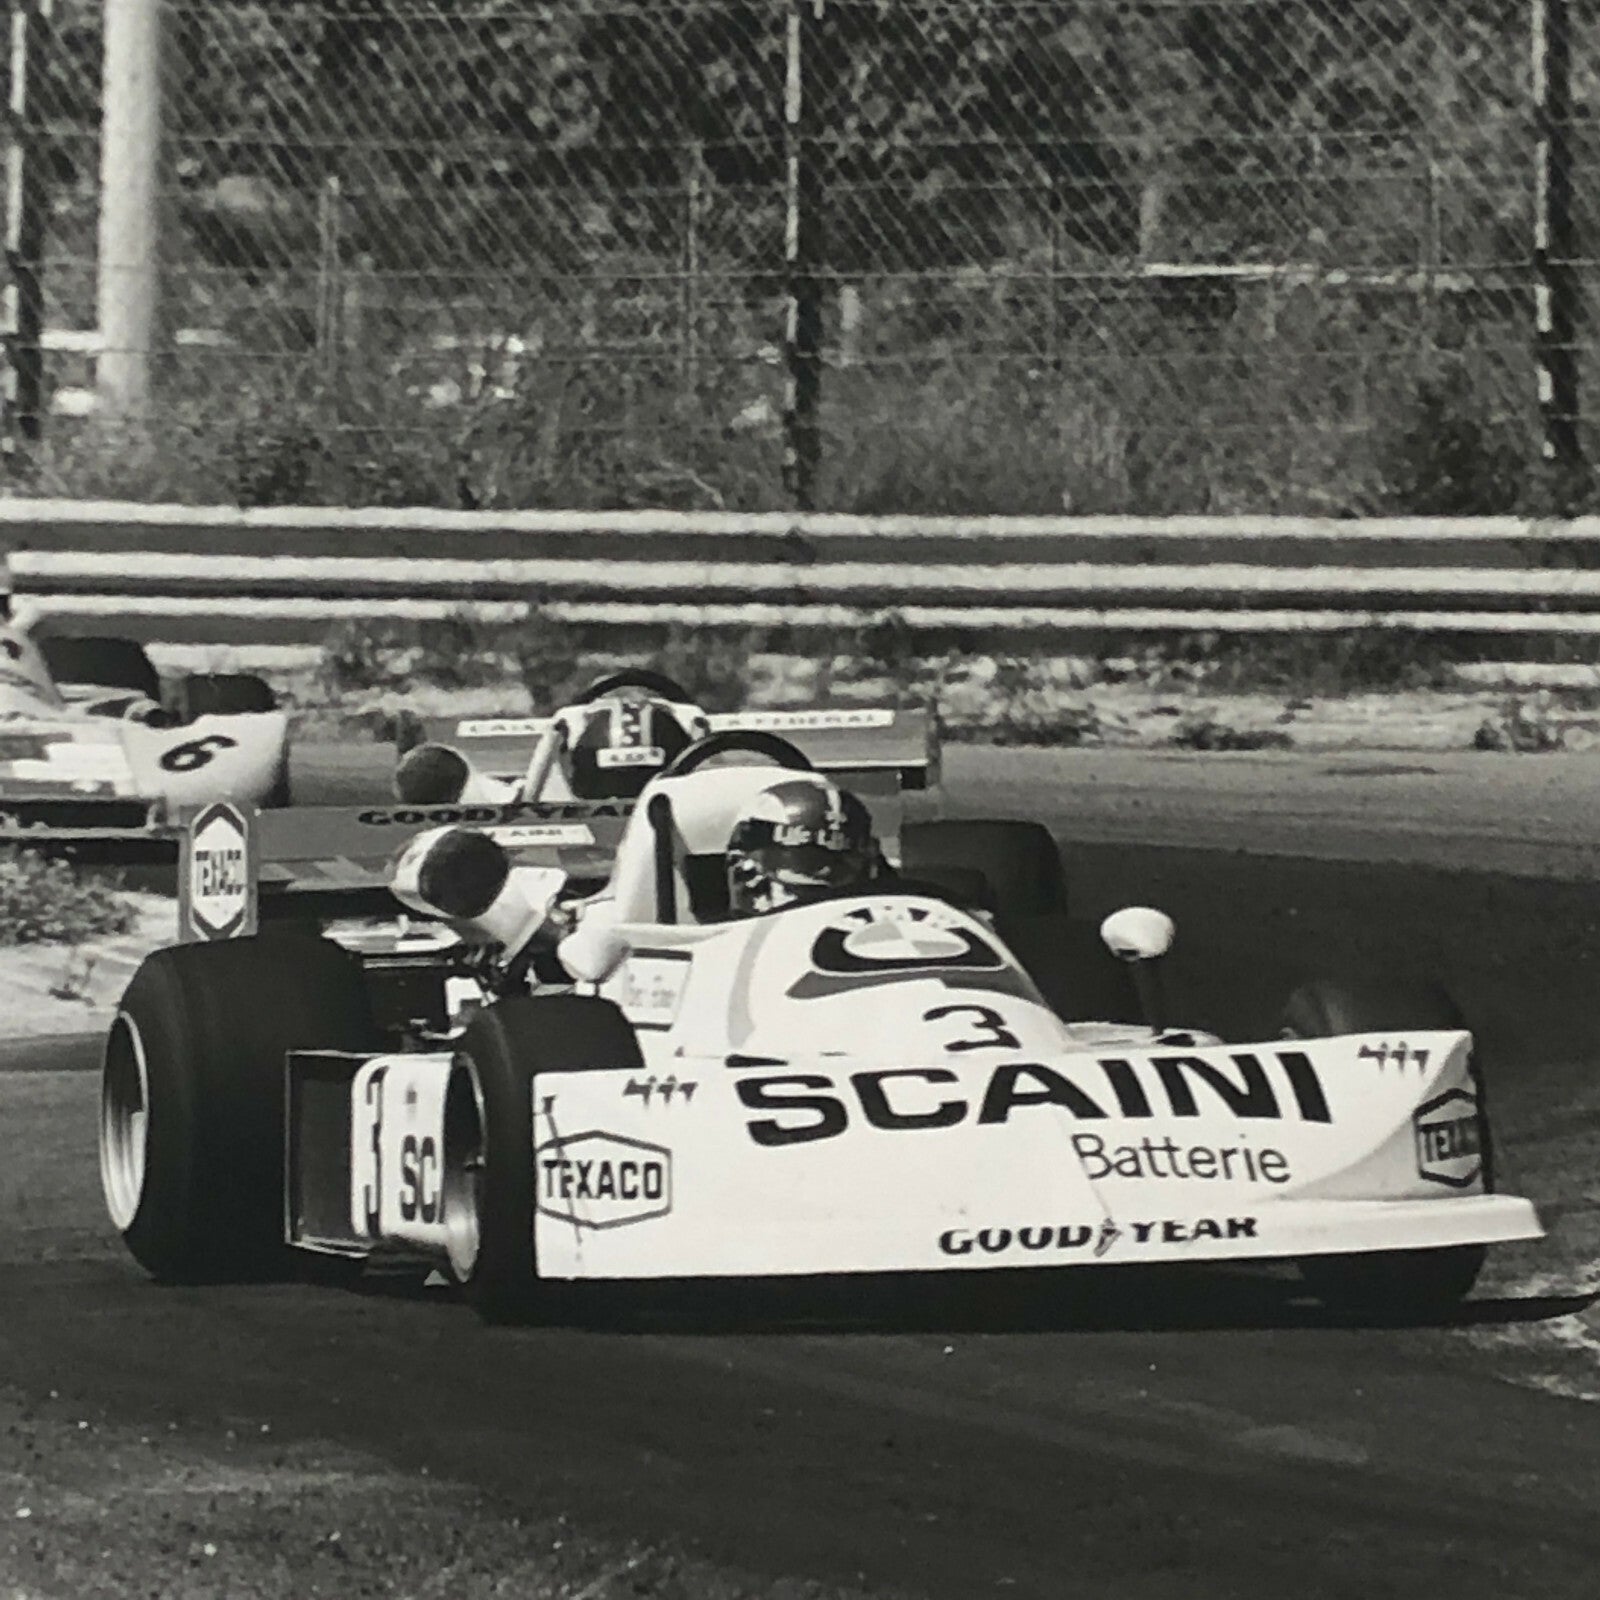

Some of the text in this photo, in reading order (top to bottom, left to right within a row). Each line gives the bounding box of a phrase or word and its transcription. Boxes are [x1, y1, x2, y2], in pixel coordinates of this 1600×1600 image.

[160, 735, 237, 773] 6
[923, 1004, 1022, 1051] 3
[735, 1052, 1332, 1146] SCAINI
[401, 1134, 447, 1224] SC
[542, 1159, 663, 1201] TEXACO
[1071, 1133, 1291, 1182] Batterie
